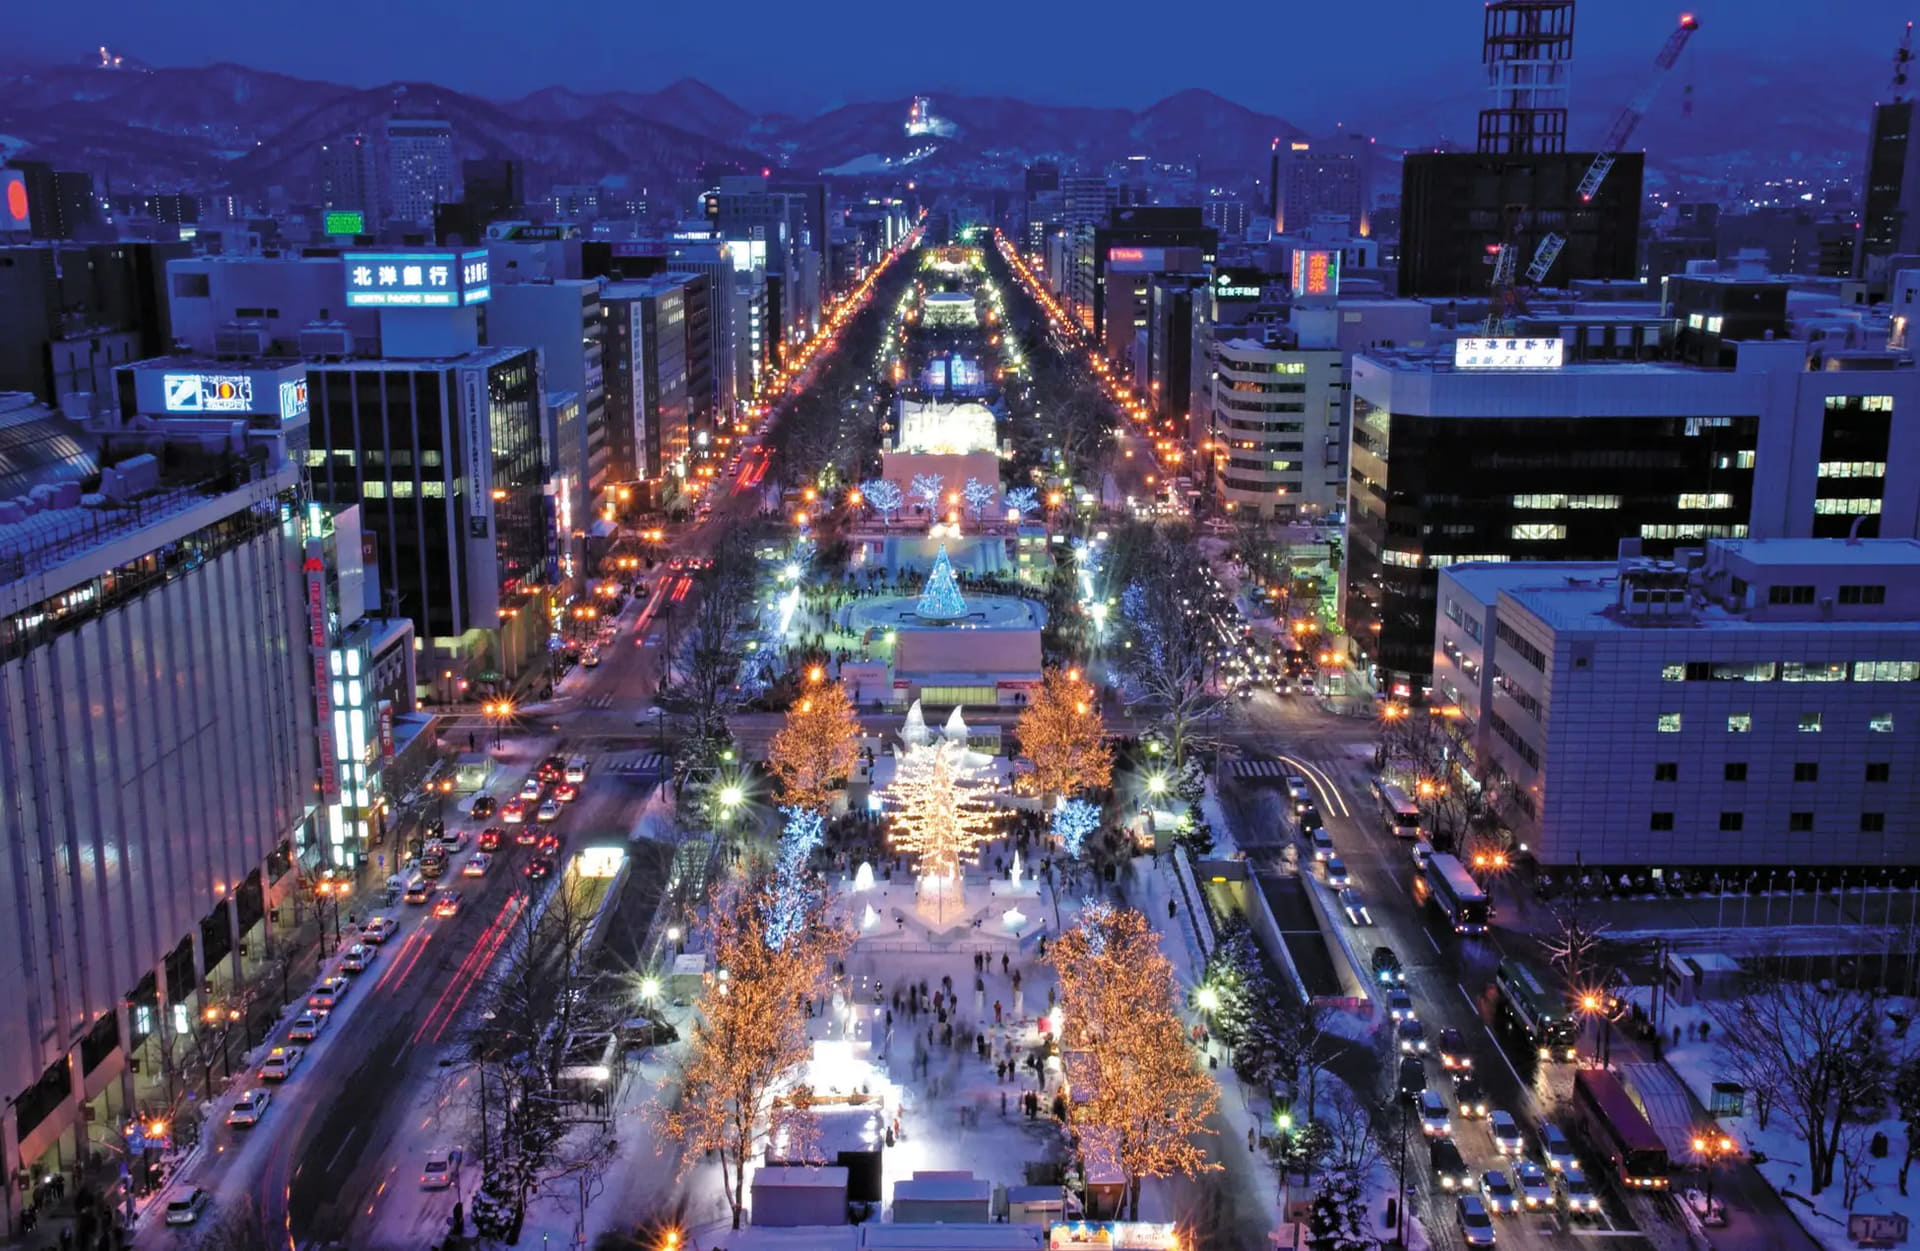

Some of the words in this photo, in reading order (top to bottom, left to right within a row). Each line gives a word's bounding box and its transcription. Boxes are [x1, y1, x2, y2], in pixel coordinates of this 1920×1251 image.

[353, 265, 448, 285] 北洋銀行
[387, 294, 421, 303] PACIFIC
[1465, 339, 1556, 350] 北海道新聞
[1466, 355, 1554, 365] 道新スポツ
